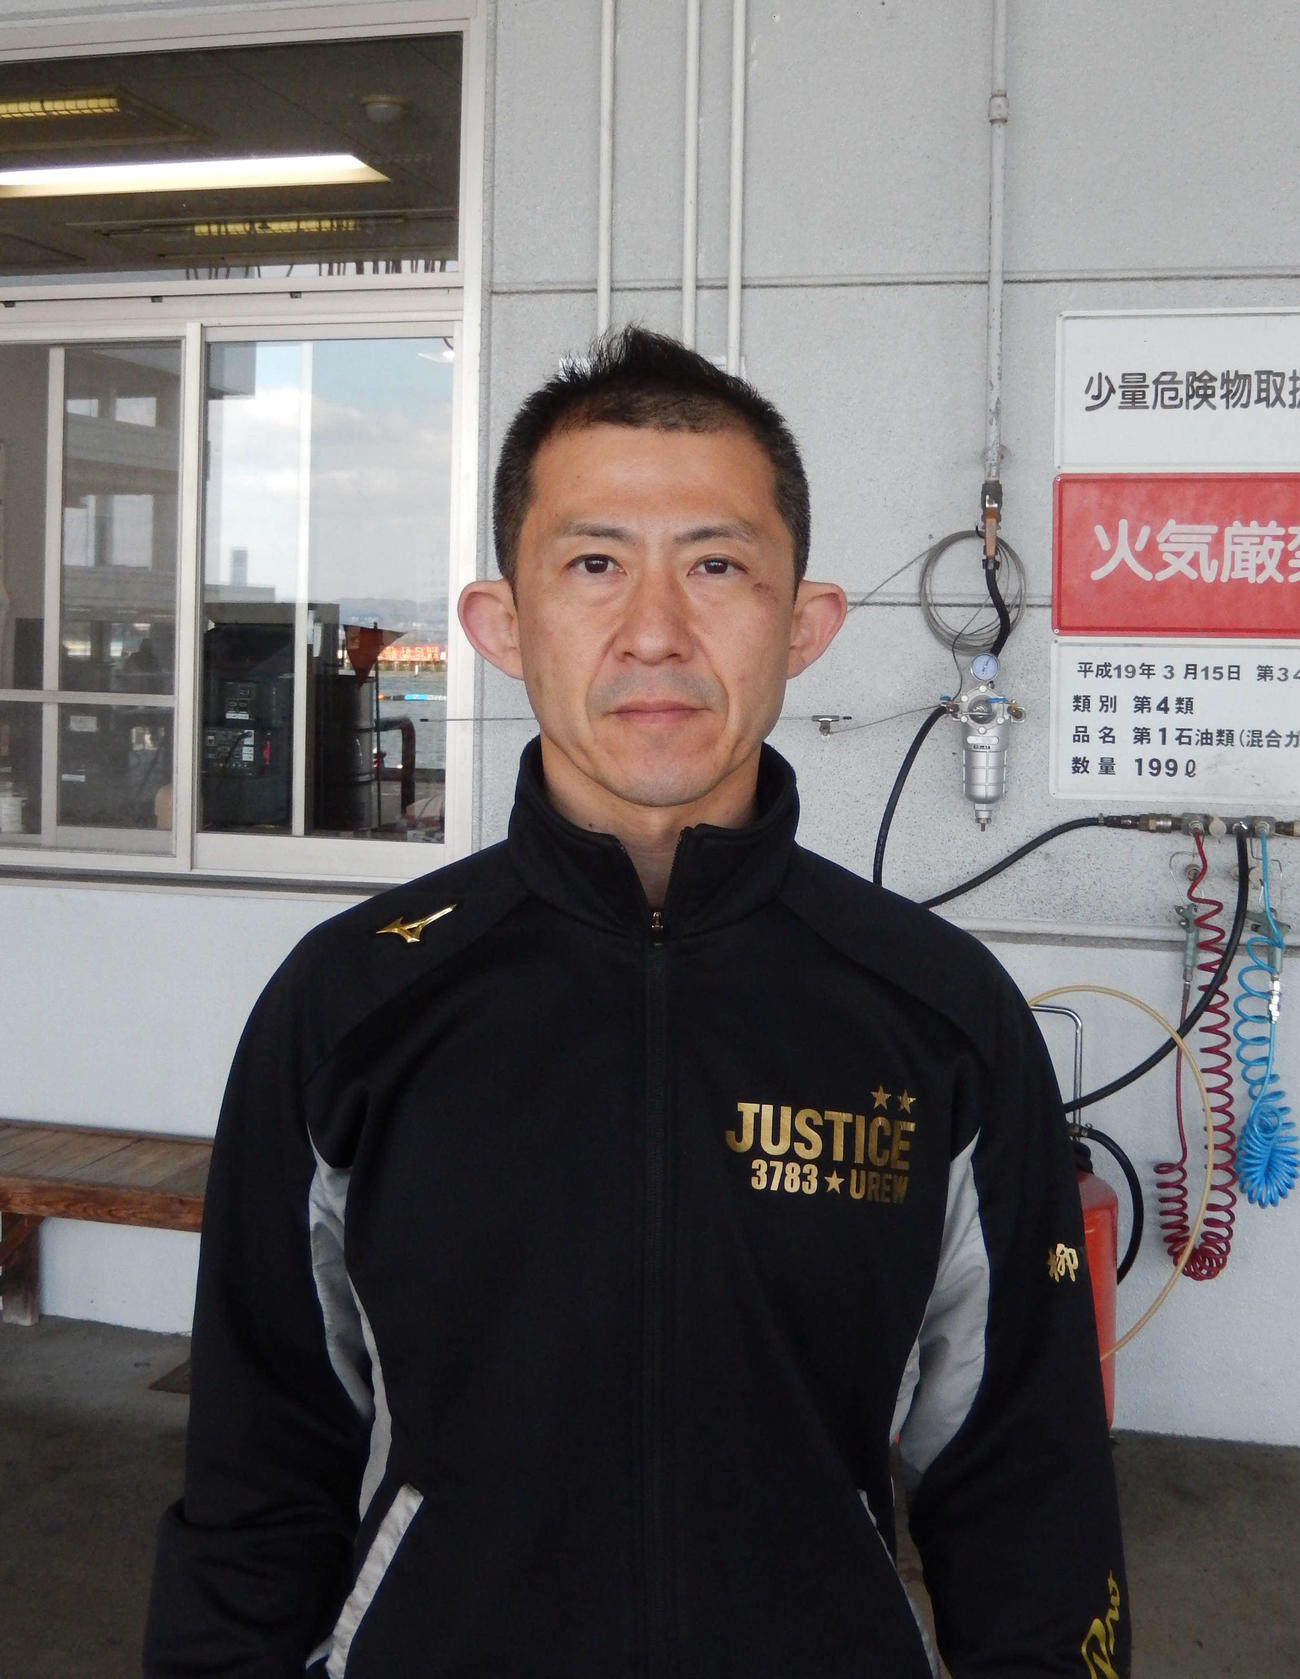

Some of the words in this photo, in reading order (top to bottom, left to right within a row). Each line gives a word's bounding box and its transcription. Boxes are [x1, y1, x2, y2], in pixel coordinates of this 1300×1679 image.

[1090, 518, 1300, 584] 火気厳
[1072, 694, 1117, 713] 類別
[1133, 695, 1194, 715] 第4類
[1072, 725, 1116, 744] 品名
[1071, 756, 1116, 776] 数量
[725, 1102, 916, 1170] JUSTICE
[751, 1159, 818, 1195] 3783
